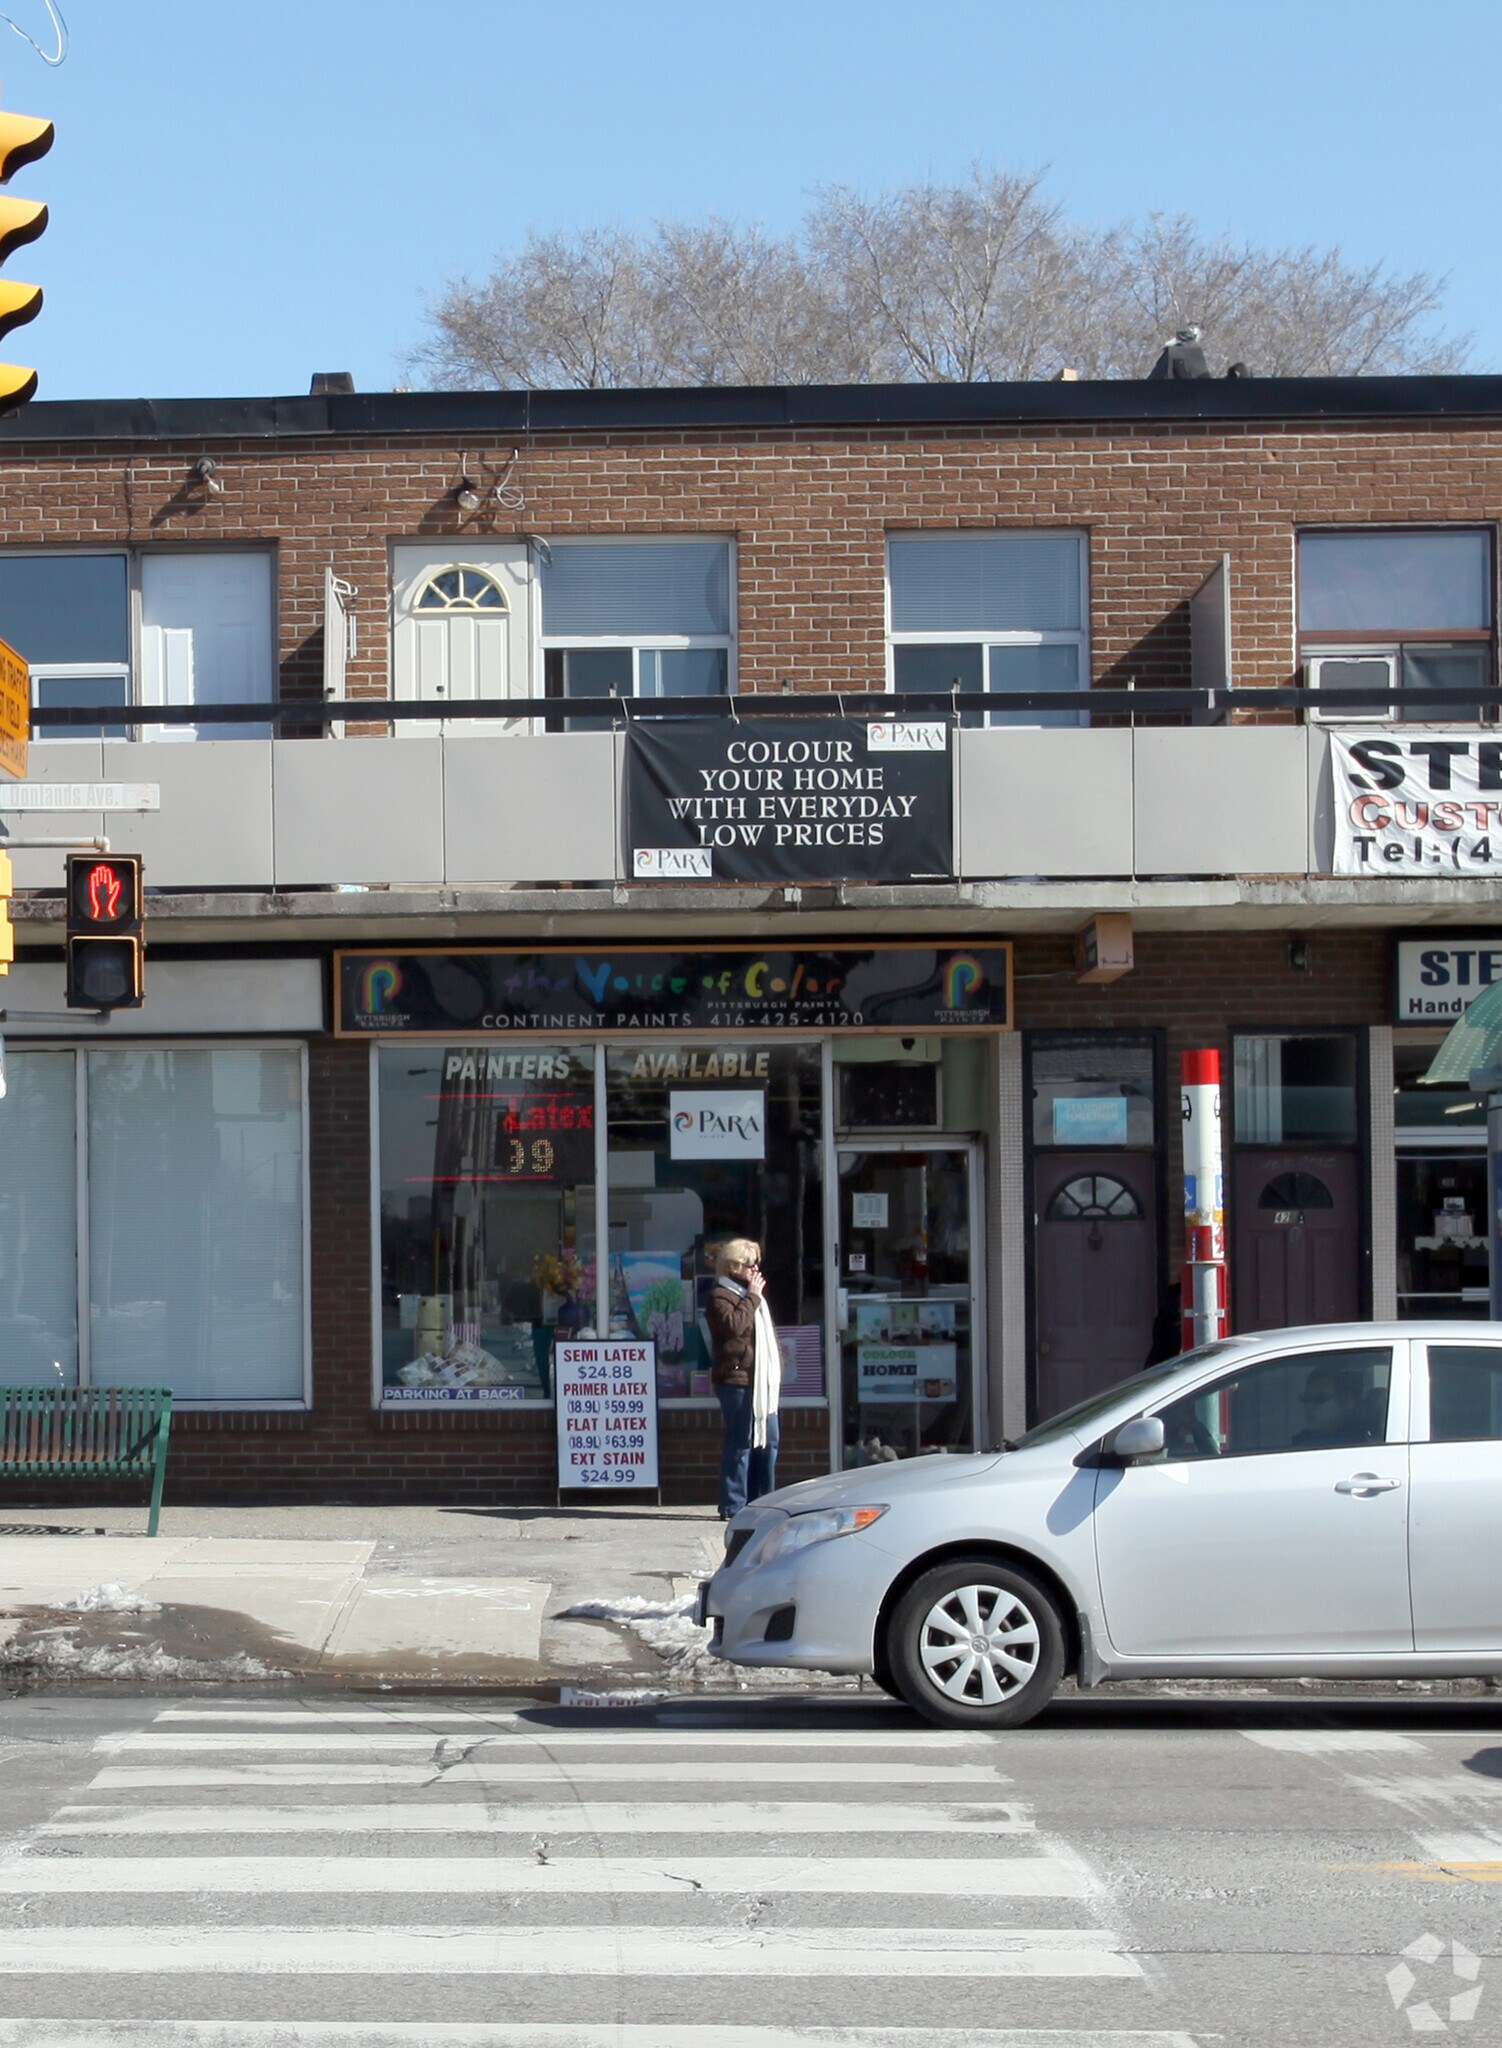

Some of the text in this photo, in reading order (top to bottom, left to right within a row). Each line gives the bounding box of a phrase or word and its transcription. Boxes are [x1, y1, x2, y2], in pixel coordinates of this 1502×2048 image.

[892, 724, 944, 749] PARA
[727, 740, 854, 763] COLOUR
[699, 767, 884, 792] YOUR HOME
[10, 784, 81, 806] Donlands
[666, 795, 917, 820] WITH EVERYDAY
[1349, 794, 1502, 831] CUST
[698, 822, 884, 847] LOW PRICES
[659, 850, 710, 875] PARA
[575, 956, 687, 1003] Voice
[702, 971, 732, 995] of
[745, 961, 842, 999] Color
[707, 1001, 788, 1009] PITTSBURGH
[482, 1012, 864, 1028] CONTINENT PAINTS 416-425-4120
[699, 1110, 760, 1140] PARA
[563, 1349, 646, 1362] SEMI LATEX
[578, 1365, 633, 1380] $24.88
[863, 1365, 917, 1376] HOME
[384, 1389, 520, 1400] PARKING AT BACK
[563, 1382, 648, 1396] PRIMER LATEX
[567, 1399, 644, 1414] (18.9L) $59.99
[567, 1417, 647, 1431] FLAT LATEX
[569, 1435, 644, 1450] (18.9L) $63.99
[571, 1452, 645, 1465] EXT STAIN
[581, 1469, 636, 1483] $24.99
